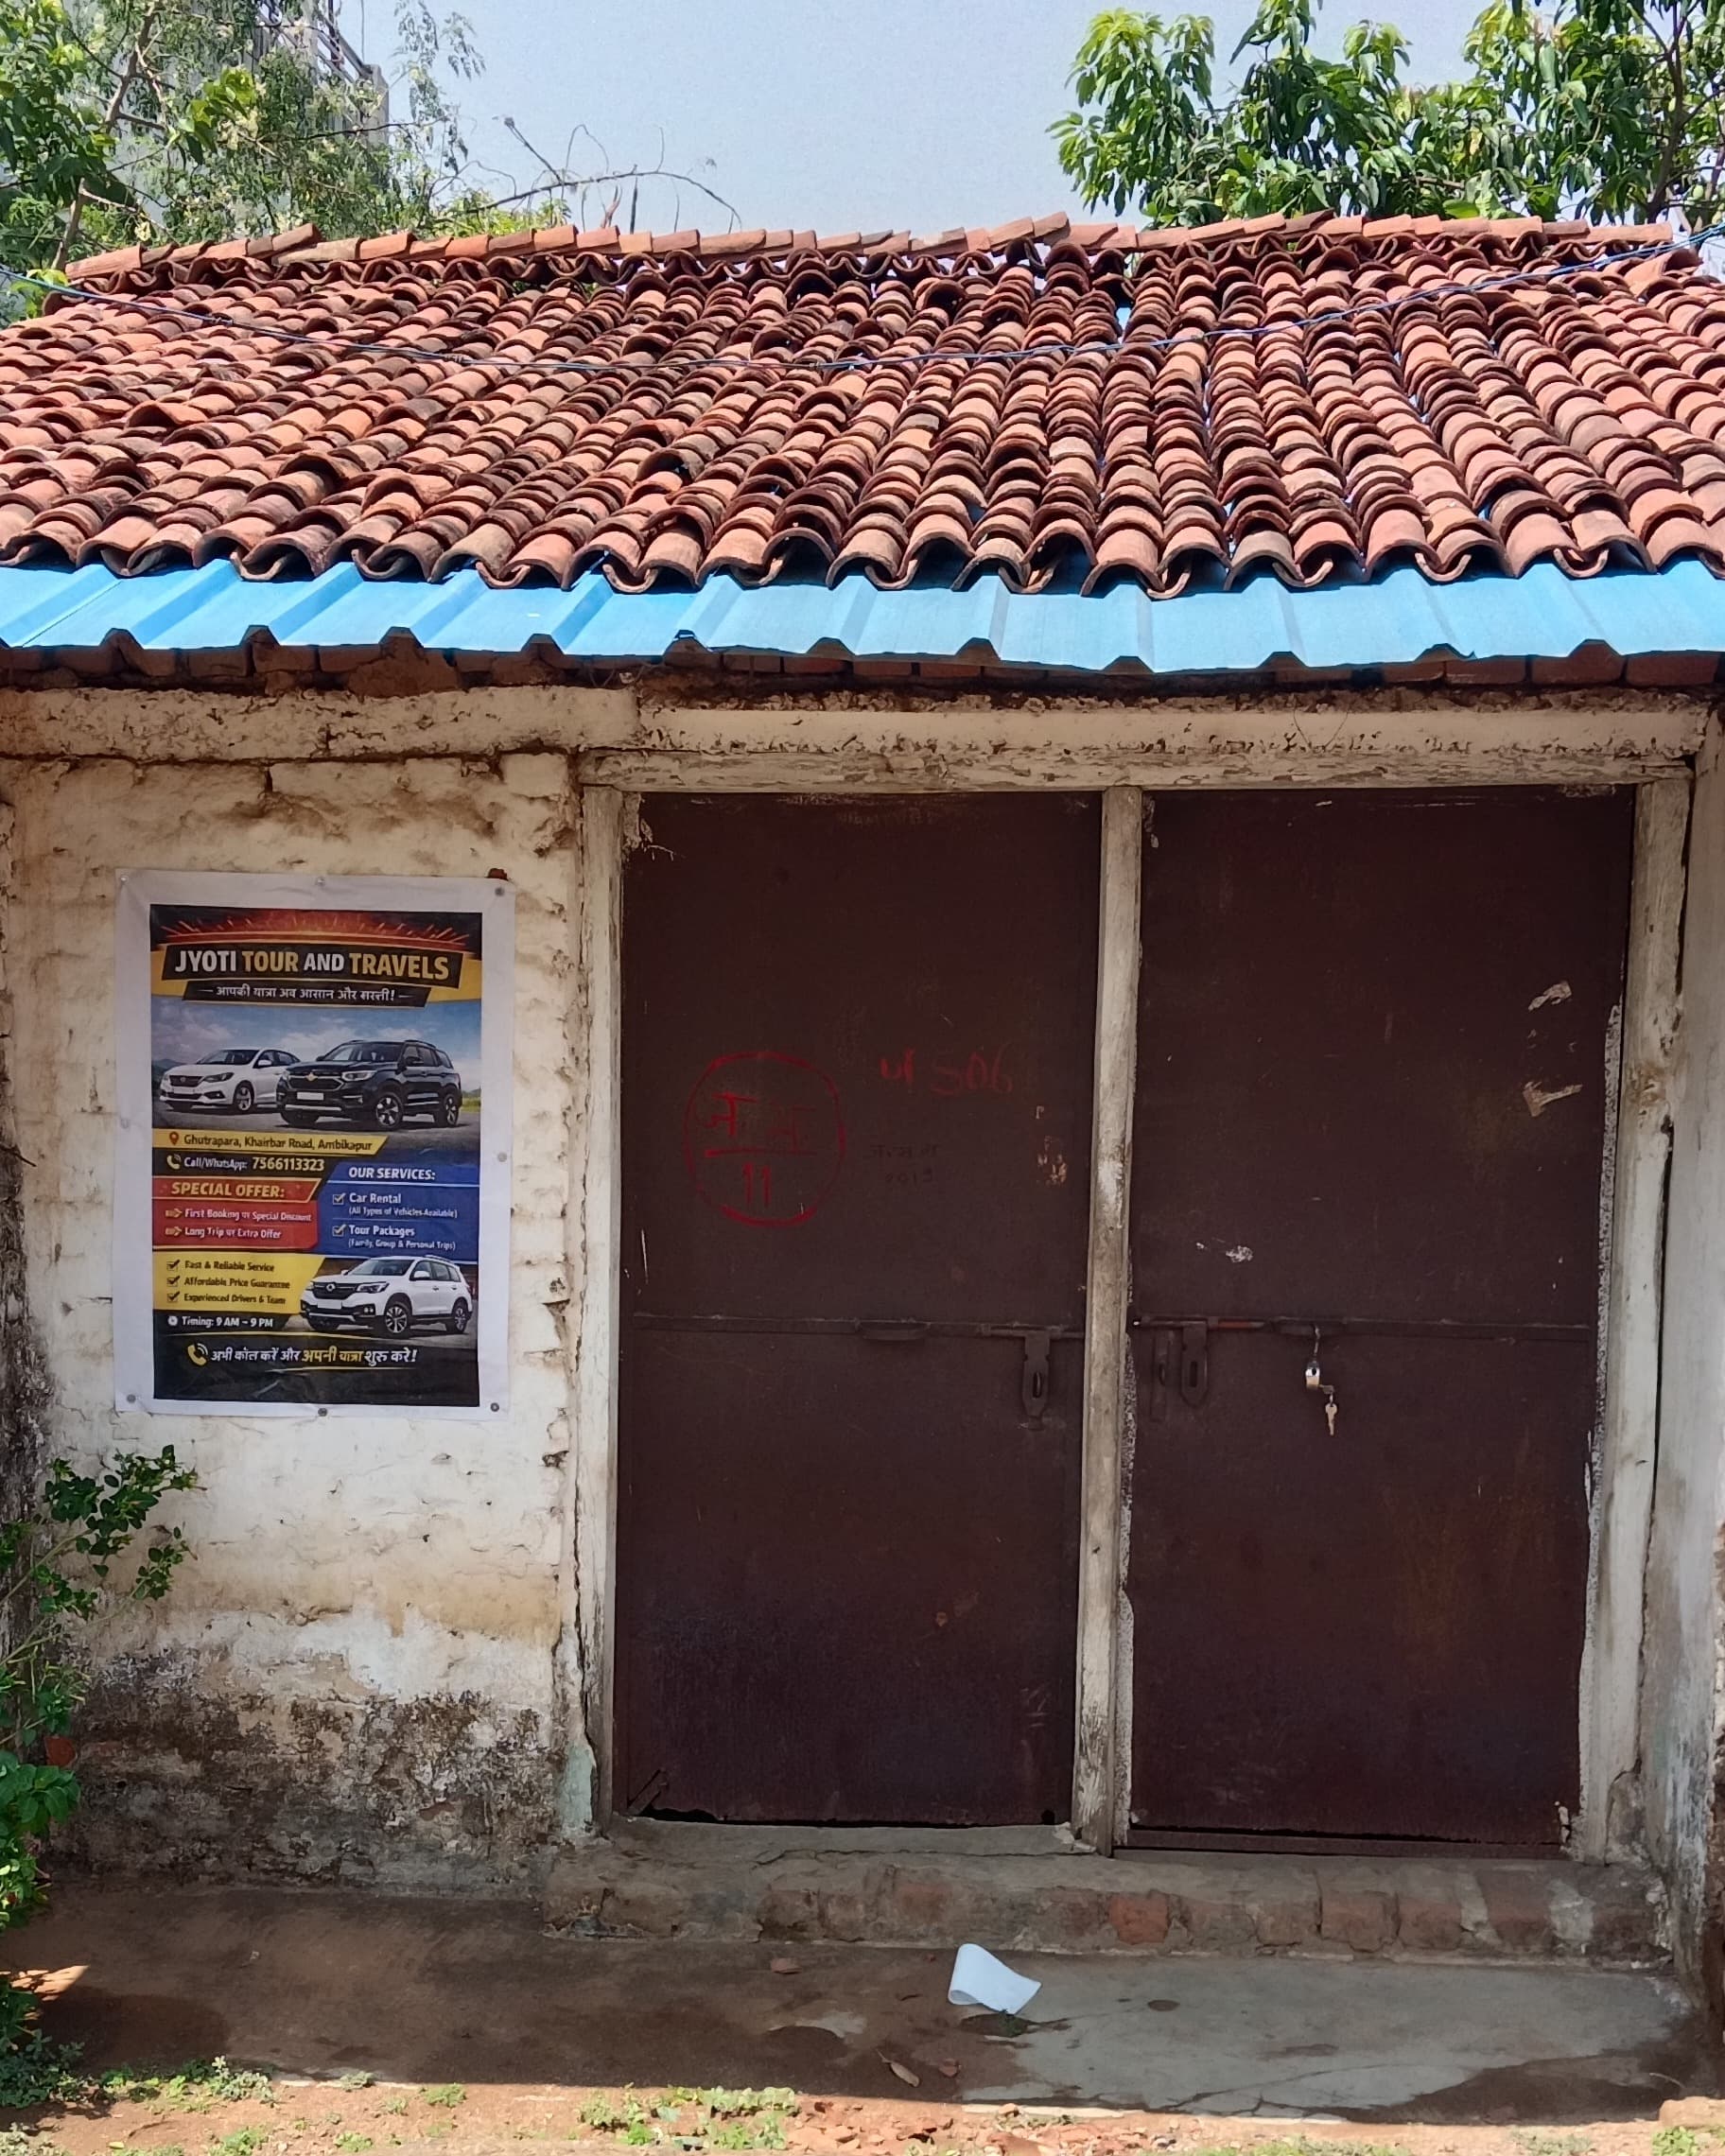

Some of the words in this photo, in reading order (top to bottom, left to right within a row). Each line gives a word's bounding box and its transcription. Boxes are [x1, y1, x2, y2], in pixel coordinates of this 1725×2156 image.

[175, 950, 236, 972] JYOTI
[242, 950, 299, 972] TOUR
[304, 952, 345, 971] AND
[349, 953, 449, 981] TRAVELS
[217, 983, 251, 998] आपकी
[253, 986, 276, 999] यात्रा
[338, 985, 357, 1000] और
[183, 1135, 242, 1148] Ghutrapara,
[245, 1137, 286, 1148] Khairbar
[288, 1138, 315, 1150] Road,
[318, 1139, 373, 1152] Ambikapur
[253, 1156, 324, 1172] 7566113323
[349, 1167, 375, 1179] OUR
[376, 1168, 436, 1180] SERVICES:
[171, 1182, 232, 1196] SPECIAL
[235, 1184, 285, 1198] OFFER:
[349, 1192, 367, 1204] Car
[370, 1193, 402, 1204] Rental
[184, 1208, 204, 1218] First
[207, 1208, 240, 1221] Booking
[252, 1210, 279, 1222] Special
[280, 1212, 311, 1222] Discount
[349, 1206, 361, 1216] (All
[363, 1207, 382, 1217] Types
[384, 1207, 392, 1215] of
[393, 1208, 423, 1216] Vehicles
[424, 1208, 458, 1218] Available)
[184, 1226, 205, 1238] Long
[207, 1226, 224, 1238] Trip
[237, 1228, 258, 1238] Extra
[261, 1228, 281, 1239] Offer
[349, 1225, 370, 1235] Tour
[373, 1226, 415, 1238] Packages
[375, 1239, 396, 1249] Group
[406, 1240, 435, 1248] Personal
[437, 1241, 456, 1251] Trips)
[184, 1261, 202, 1269] Fast
[214, 1261, 246, 1270] Reliable
[248, 1261, 274, 1272] Service
[183, 1278, 227, 1286] Affordable
[229, 1278, 249, 1287] Price
[251, 1278, 290, 1289] Guarantee
[183, 1294, 230, 1303] Experienced
[232, 1294, 257, 1303] Drivers
[258, 1295, 264, 1303] &
[267, 1295, 286, 1304] Team
[182, 1315, 214, 1329] Timing:
[216, 1316, 222, 1326] 9
[223, 1317, 239, 1327] AM
[250, 1317, 256, 1327] 9
[259, 1318, 273, 1328] PM
[211, 1347, 233, 1362] अभी
[260, 1347, 279, 1361] करें
[280, 1347, 301, 1362] और
[302, 1346, 338, 1362] अपनी
[339, 1350, 364, 1362] यात्रा
